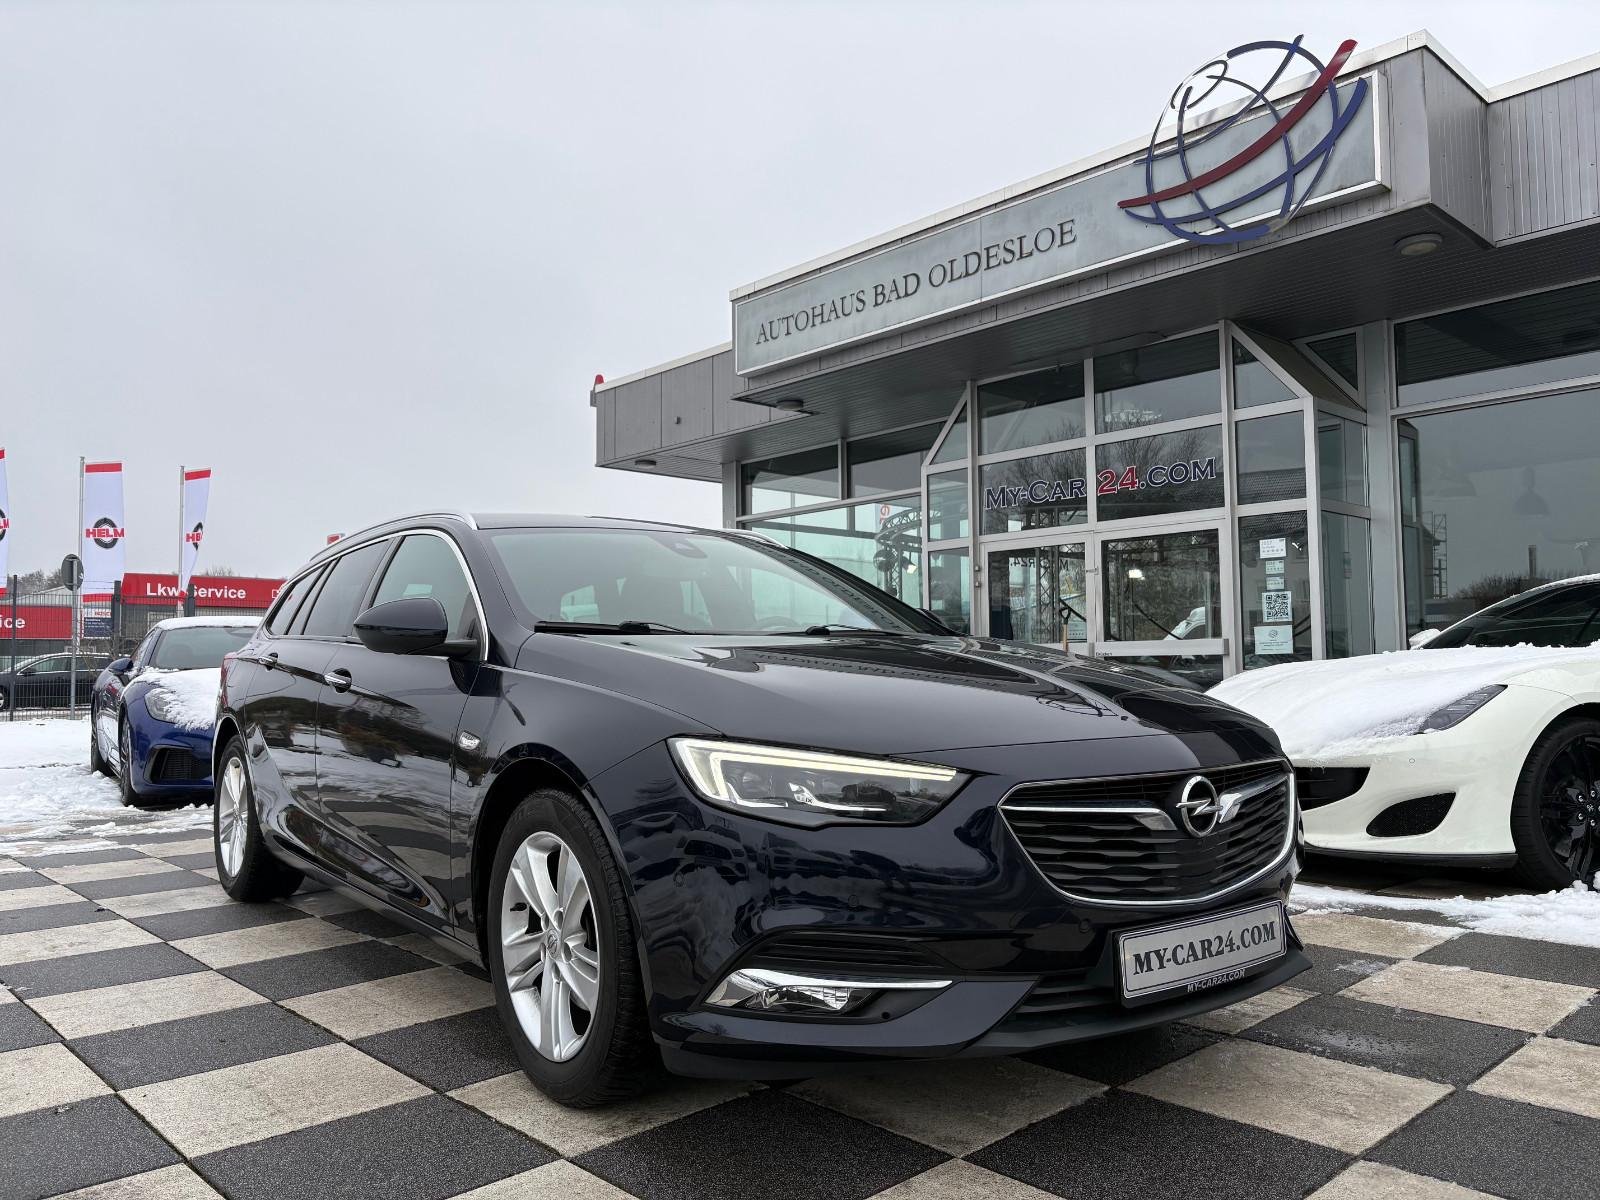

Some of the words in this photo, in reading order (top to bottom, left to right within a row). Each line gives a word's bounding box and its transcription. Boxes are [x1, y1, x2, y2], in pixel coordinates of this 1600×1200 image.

[755, 289, 866, 345] AUTOHAUS
[872, 272, 920, 308] BAD
[928, 219, 1077, 289] OLDESLOE
[86, 528, 124, 538] HELM
[146, 582, 179, 596] Lkw
[1133, 920, 1276, 975] MY-CAR24.COM
[1187, 968, 1246, 992] MY-CAR24.COM
